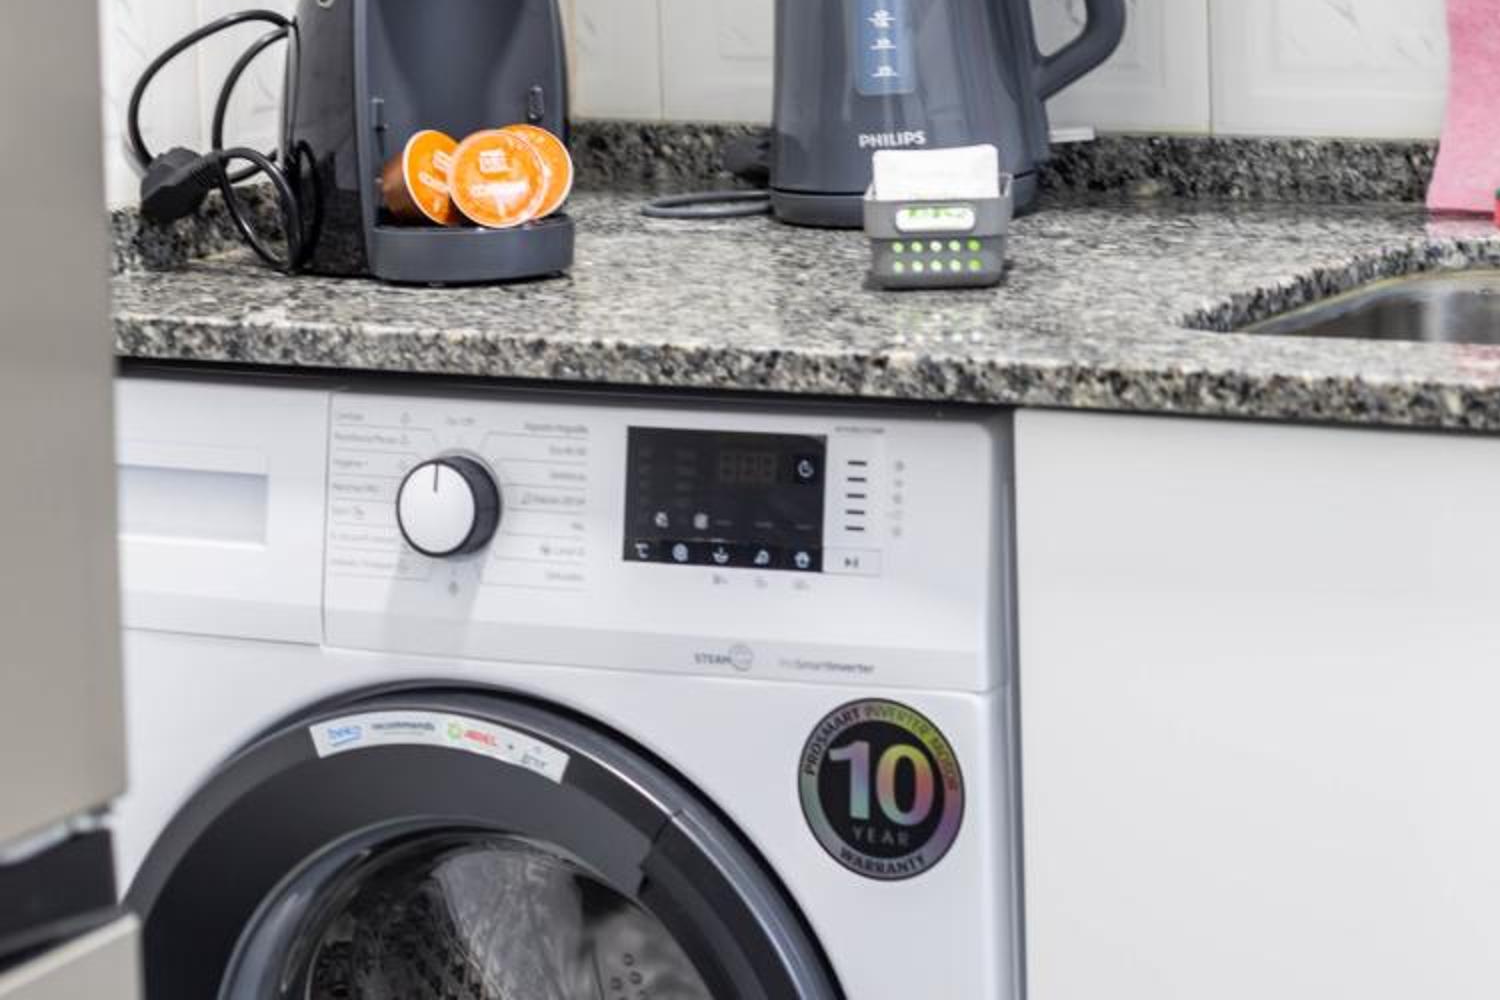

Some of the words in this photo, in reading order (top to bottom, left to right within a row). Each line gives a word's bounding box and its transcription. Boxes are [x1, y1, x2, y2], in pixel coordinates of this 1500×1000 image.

[859, 131, 926, 148] PHILIPS
[828, 740, 935, 826] 10
[852, 825, 910, 846] YEAR
